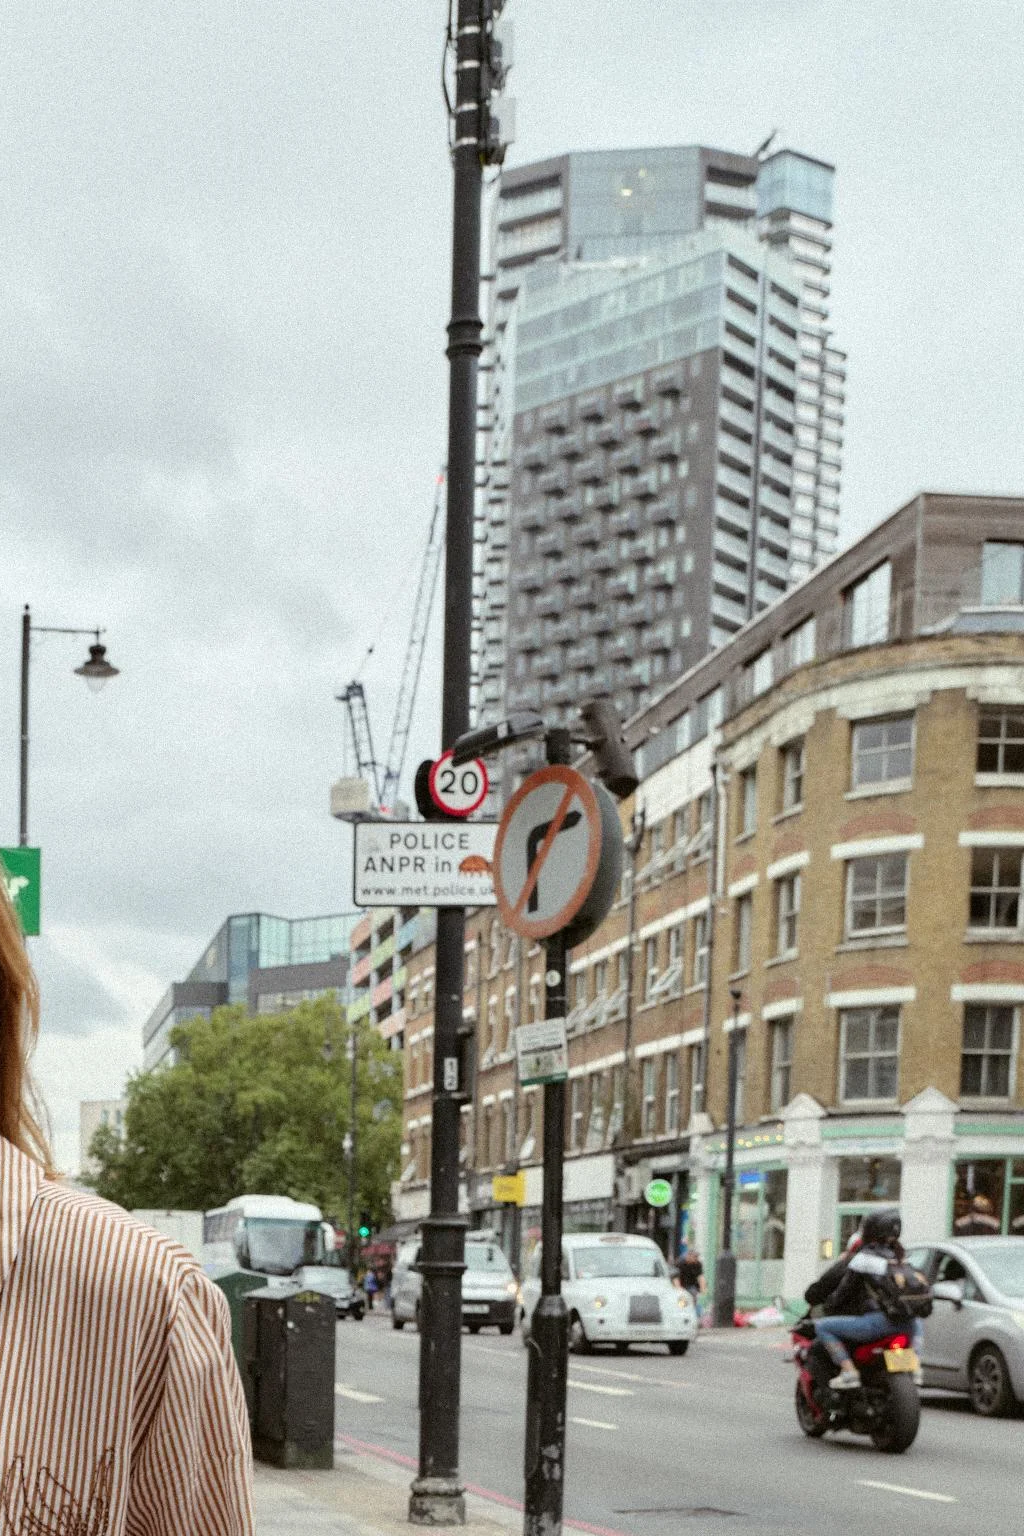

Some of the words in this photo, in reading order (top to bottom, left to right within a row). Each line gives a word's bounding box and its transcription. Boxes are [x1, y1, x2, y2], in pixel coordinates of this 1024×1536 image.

[440, 769, 478, 795] 20
[390, 833, 469, 850] POLICE
[364, 856, 425, 873] ANPR
[435, 857, 452, 873] in
